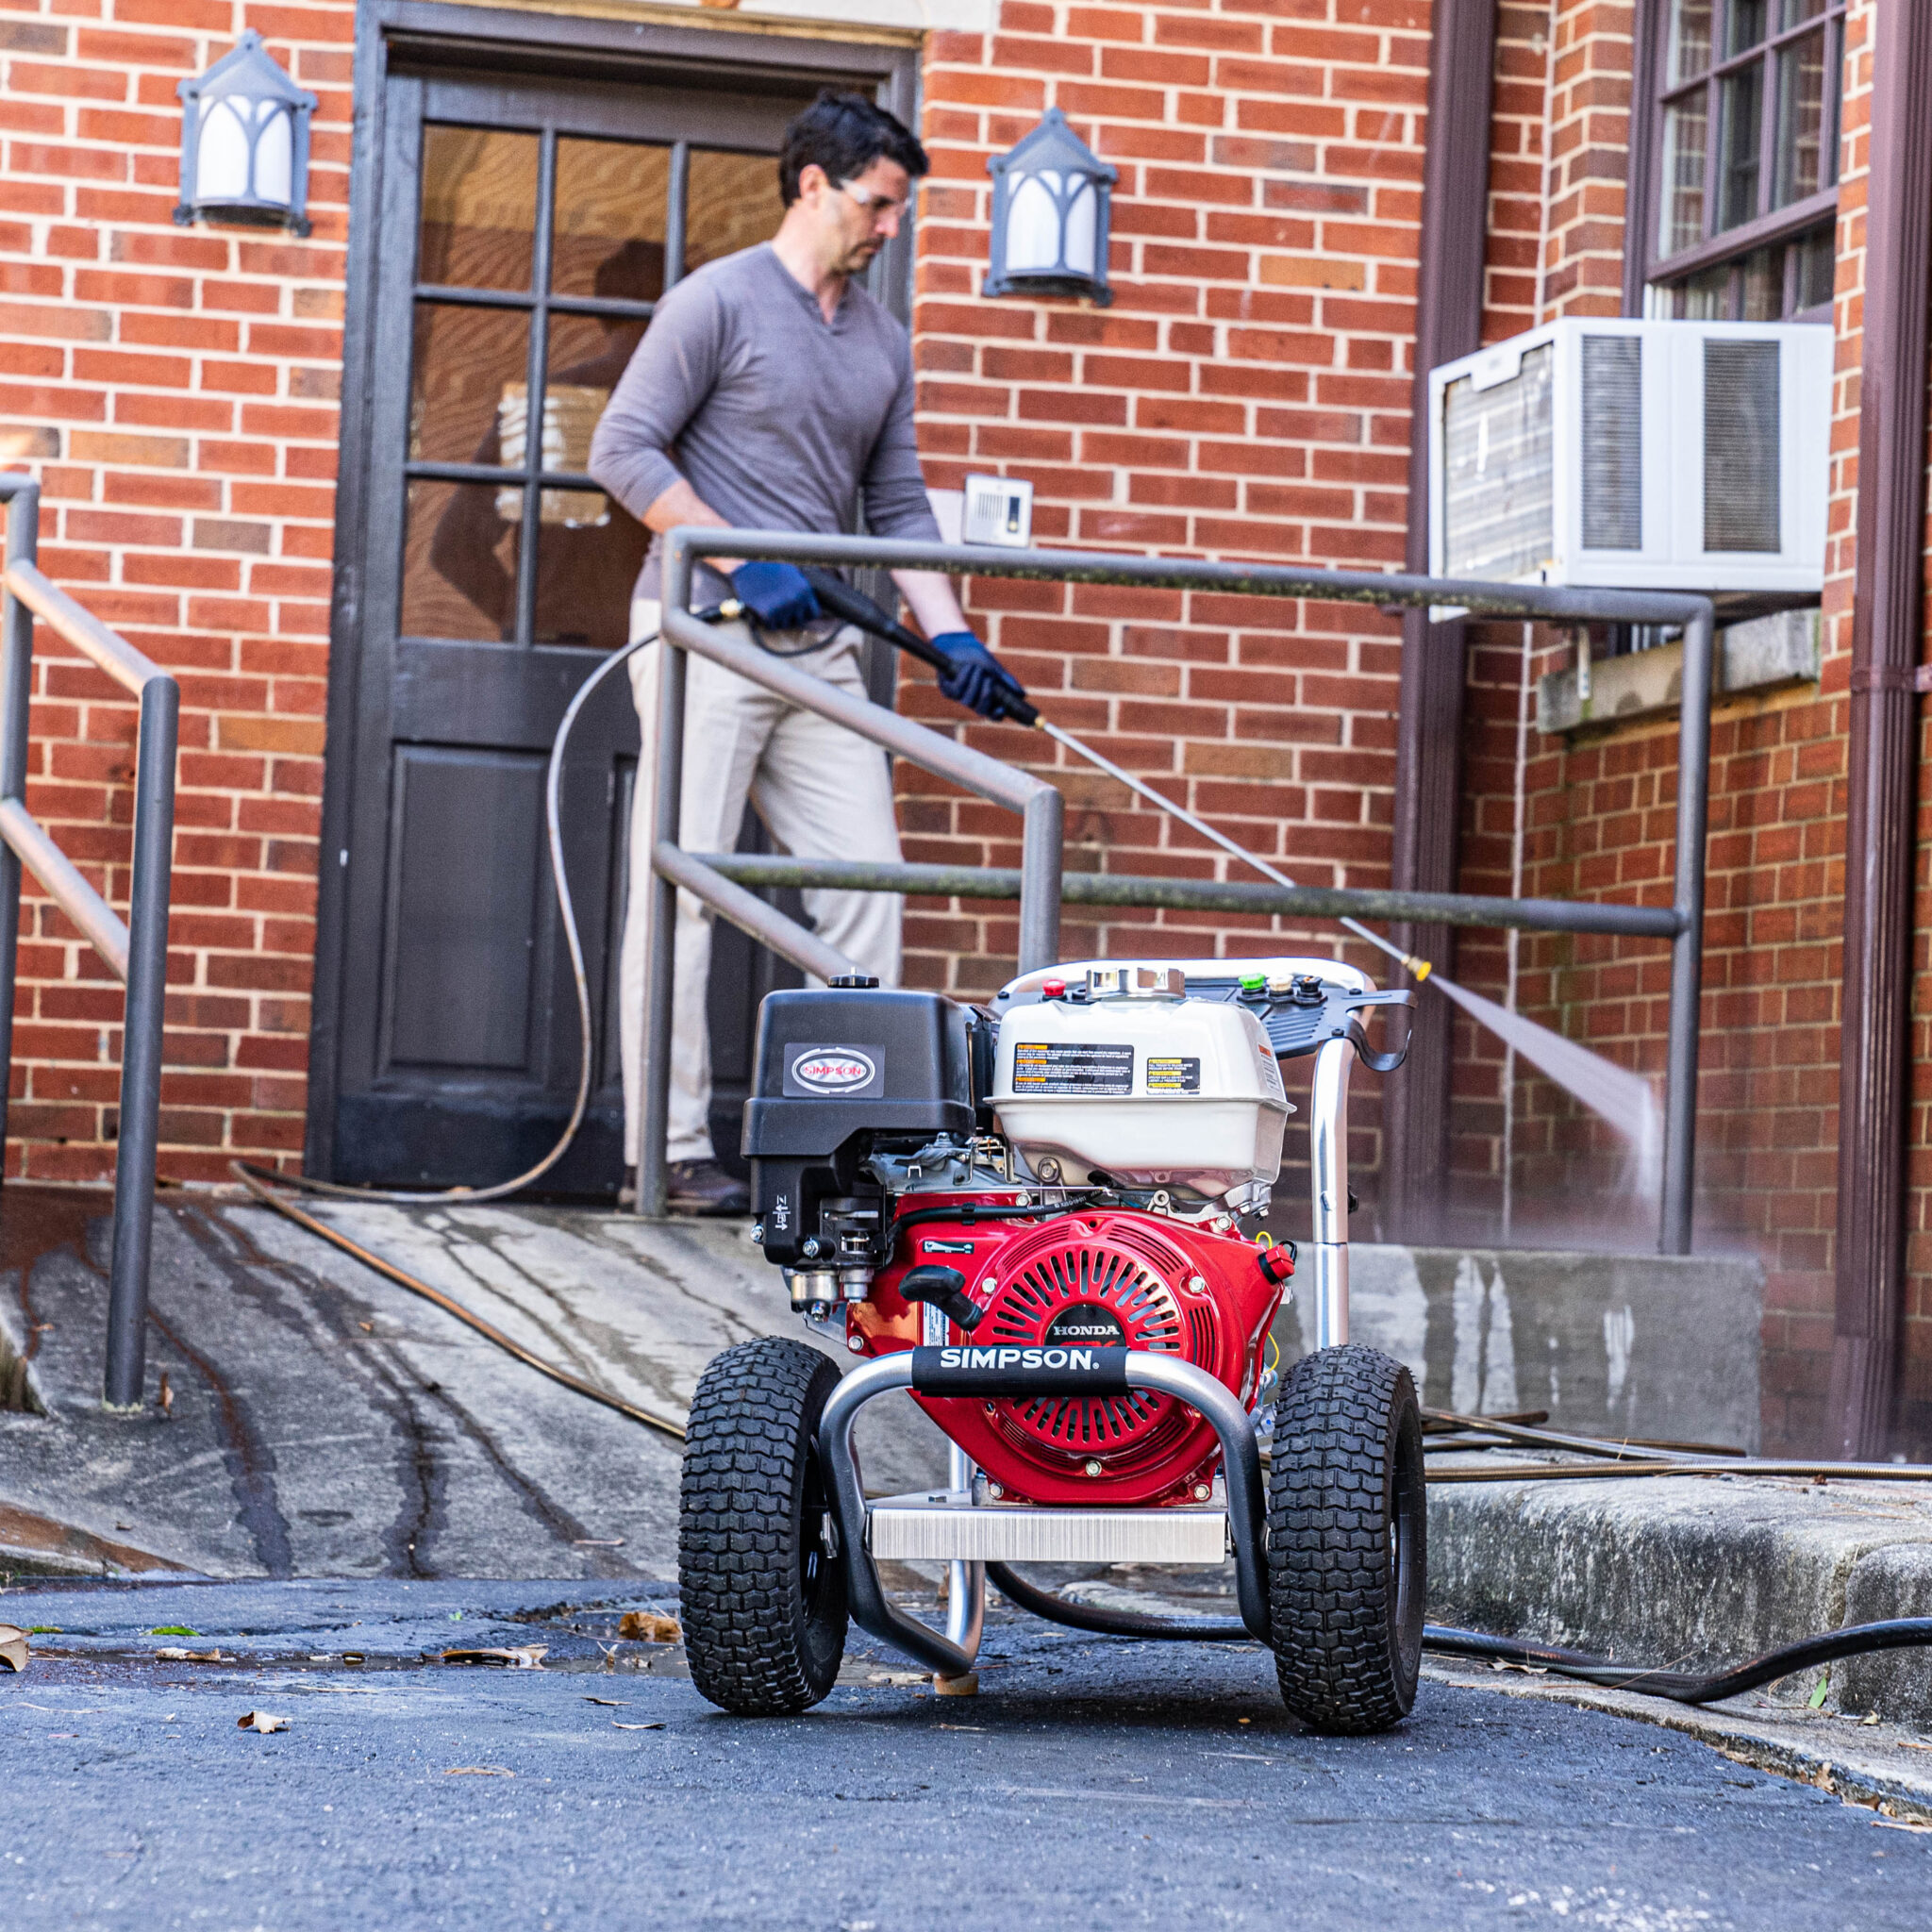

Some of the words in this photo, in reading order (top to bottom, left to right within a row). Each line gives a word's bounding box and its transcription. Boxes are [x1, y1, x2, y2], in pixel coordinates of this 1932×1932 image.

[804, 1064, 861, 1075] SIMPSON
[1054, 1325, 1120, 1336] HONDA
[941, 1348, 1093, 1370] SIMPSON
